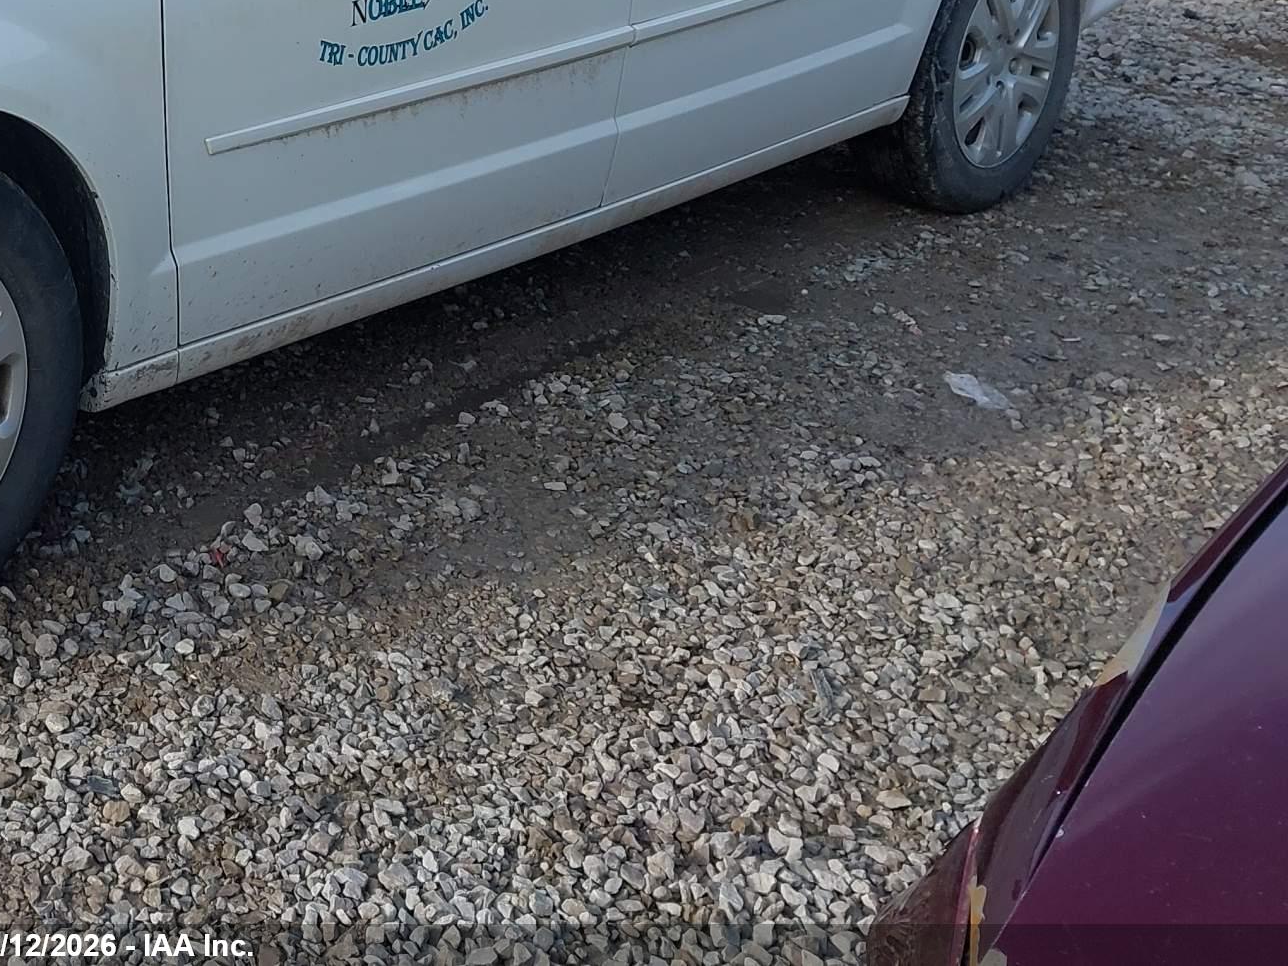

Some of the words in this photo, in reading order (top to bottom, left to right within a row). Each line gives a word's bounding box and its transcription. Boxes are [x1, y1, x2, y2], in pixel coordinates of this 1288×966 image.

[320, 41, 346, 65] TRI
[357, 31, 423, 66] COUNTY
[423, 19, 458, 50] CAC,
